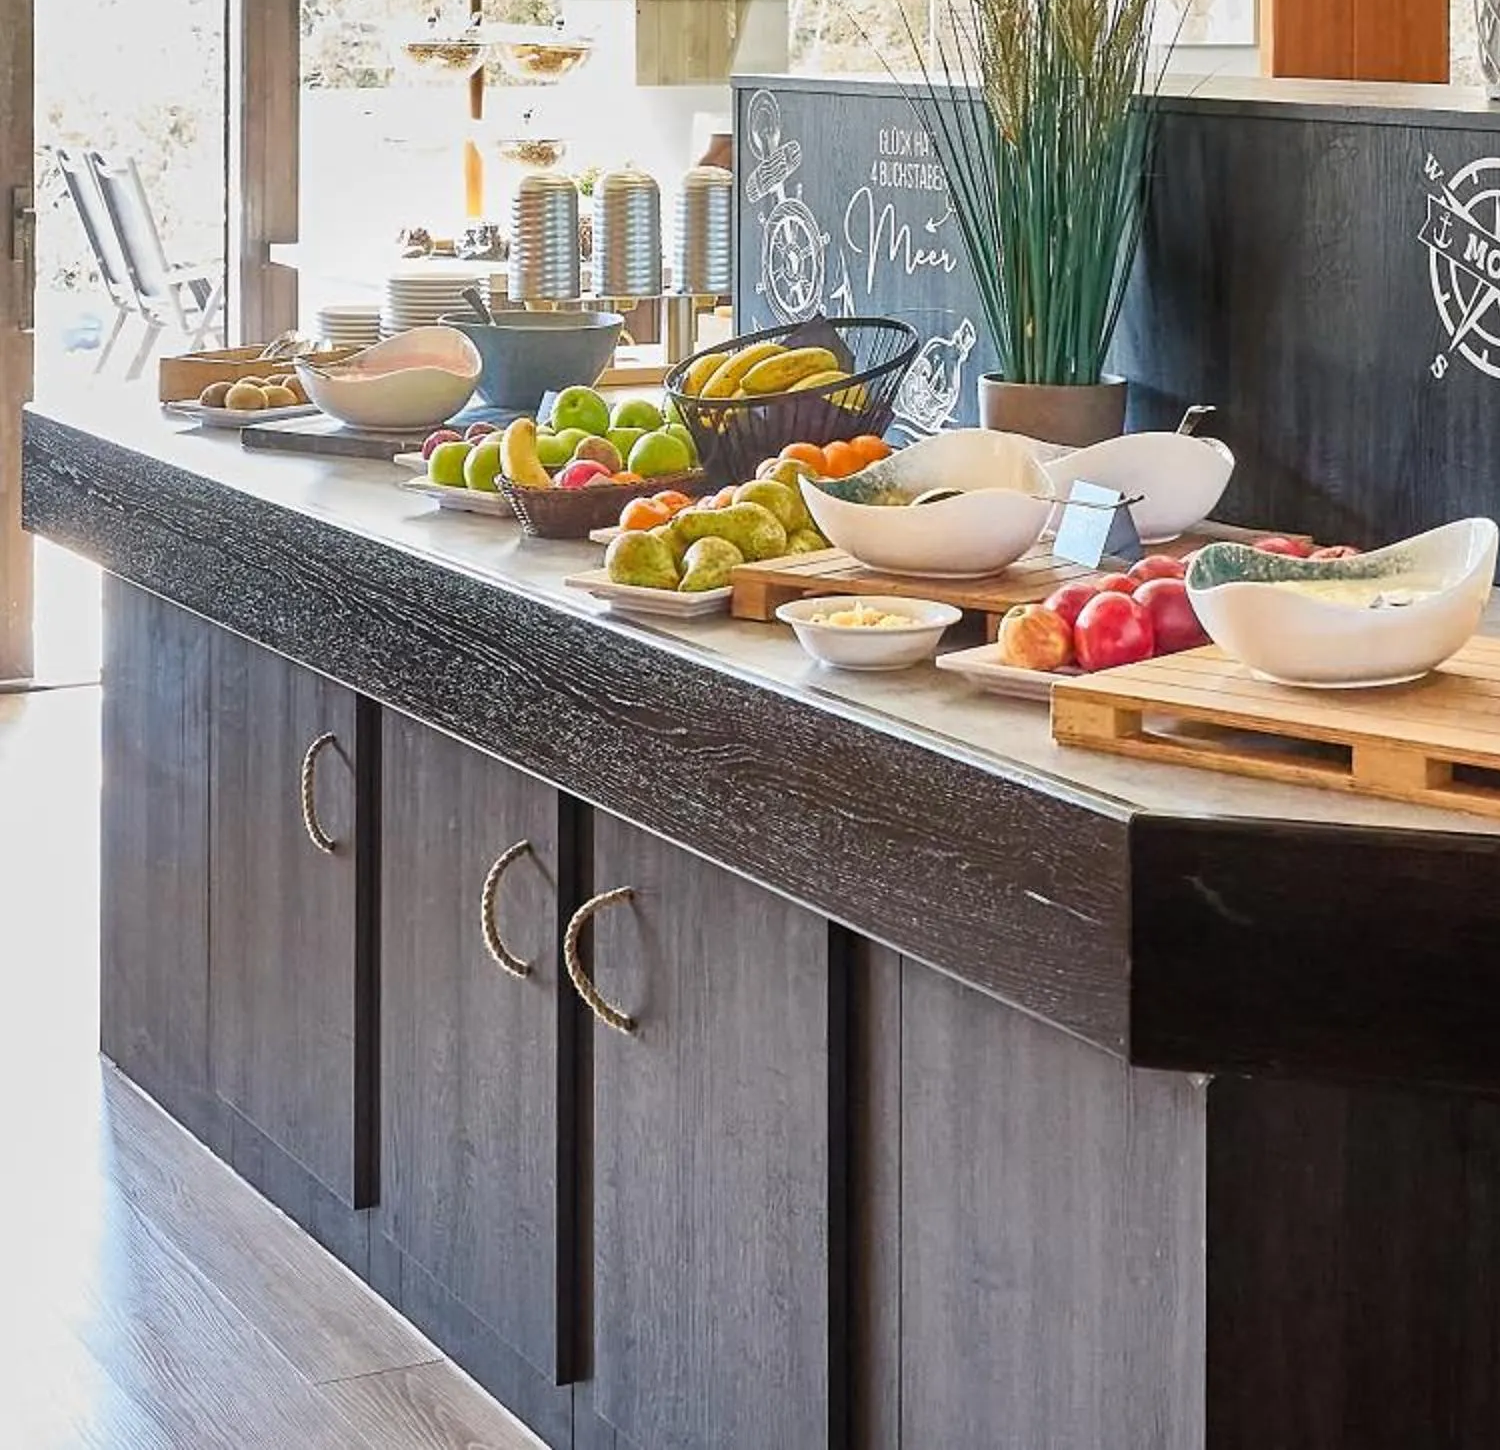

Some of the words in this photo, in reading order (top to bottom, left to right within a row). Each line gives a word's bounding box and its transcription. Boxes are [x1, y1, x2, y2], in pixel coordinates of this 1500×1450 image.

[1424, 153, 1444, 181] W
[843, 186, 956, 294] Meer
[1430, 354, 1449, 379] S
